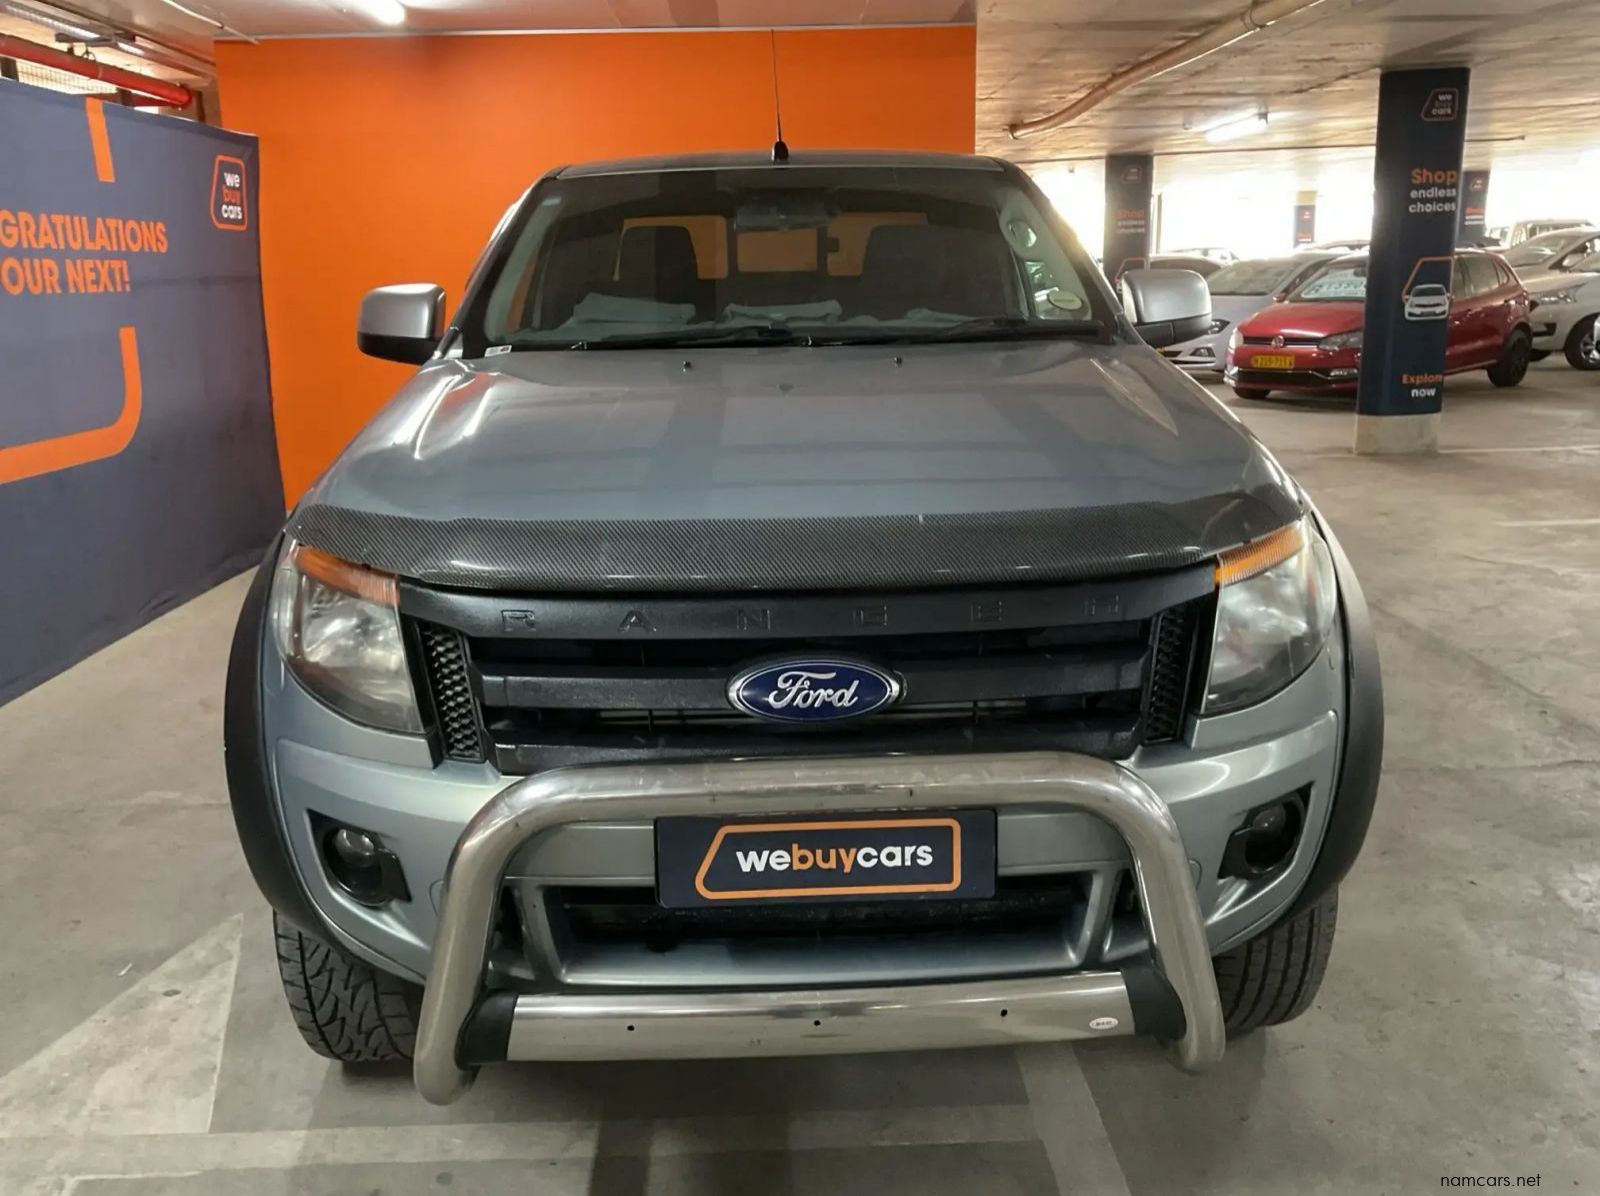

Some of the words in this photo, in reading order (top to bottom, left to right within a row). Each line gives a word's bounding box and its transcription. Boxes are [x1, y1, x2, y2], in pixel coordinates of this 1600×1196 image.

[223, 172, 241, 188] we
[1411, 168, 1458, 186] Shop
[1410, 187, 1457, 199] endless
[221, 204, 243, 220] cars
[1408, 201, 1457, 213] choices
[0, 209, 168, 254] GRATULATIONS
[1, 257, 62, 295] OUR
[65, 258, 131, 294] NEXT!
[1411, 387, 1437, 398] now
[761, 670, 860, 710] Ford
[735, 843, 934, 874] webuycars
